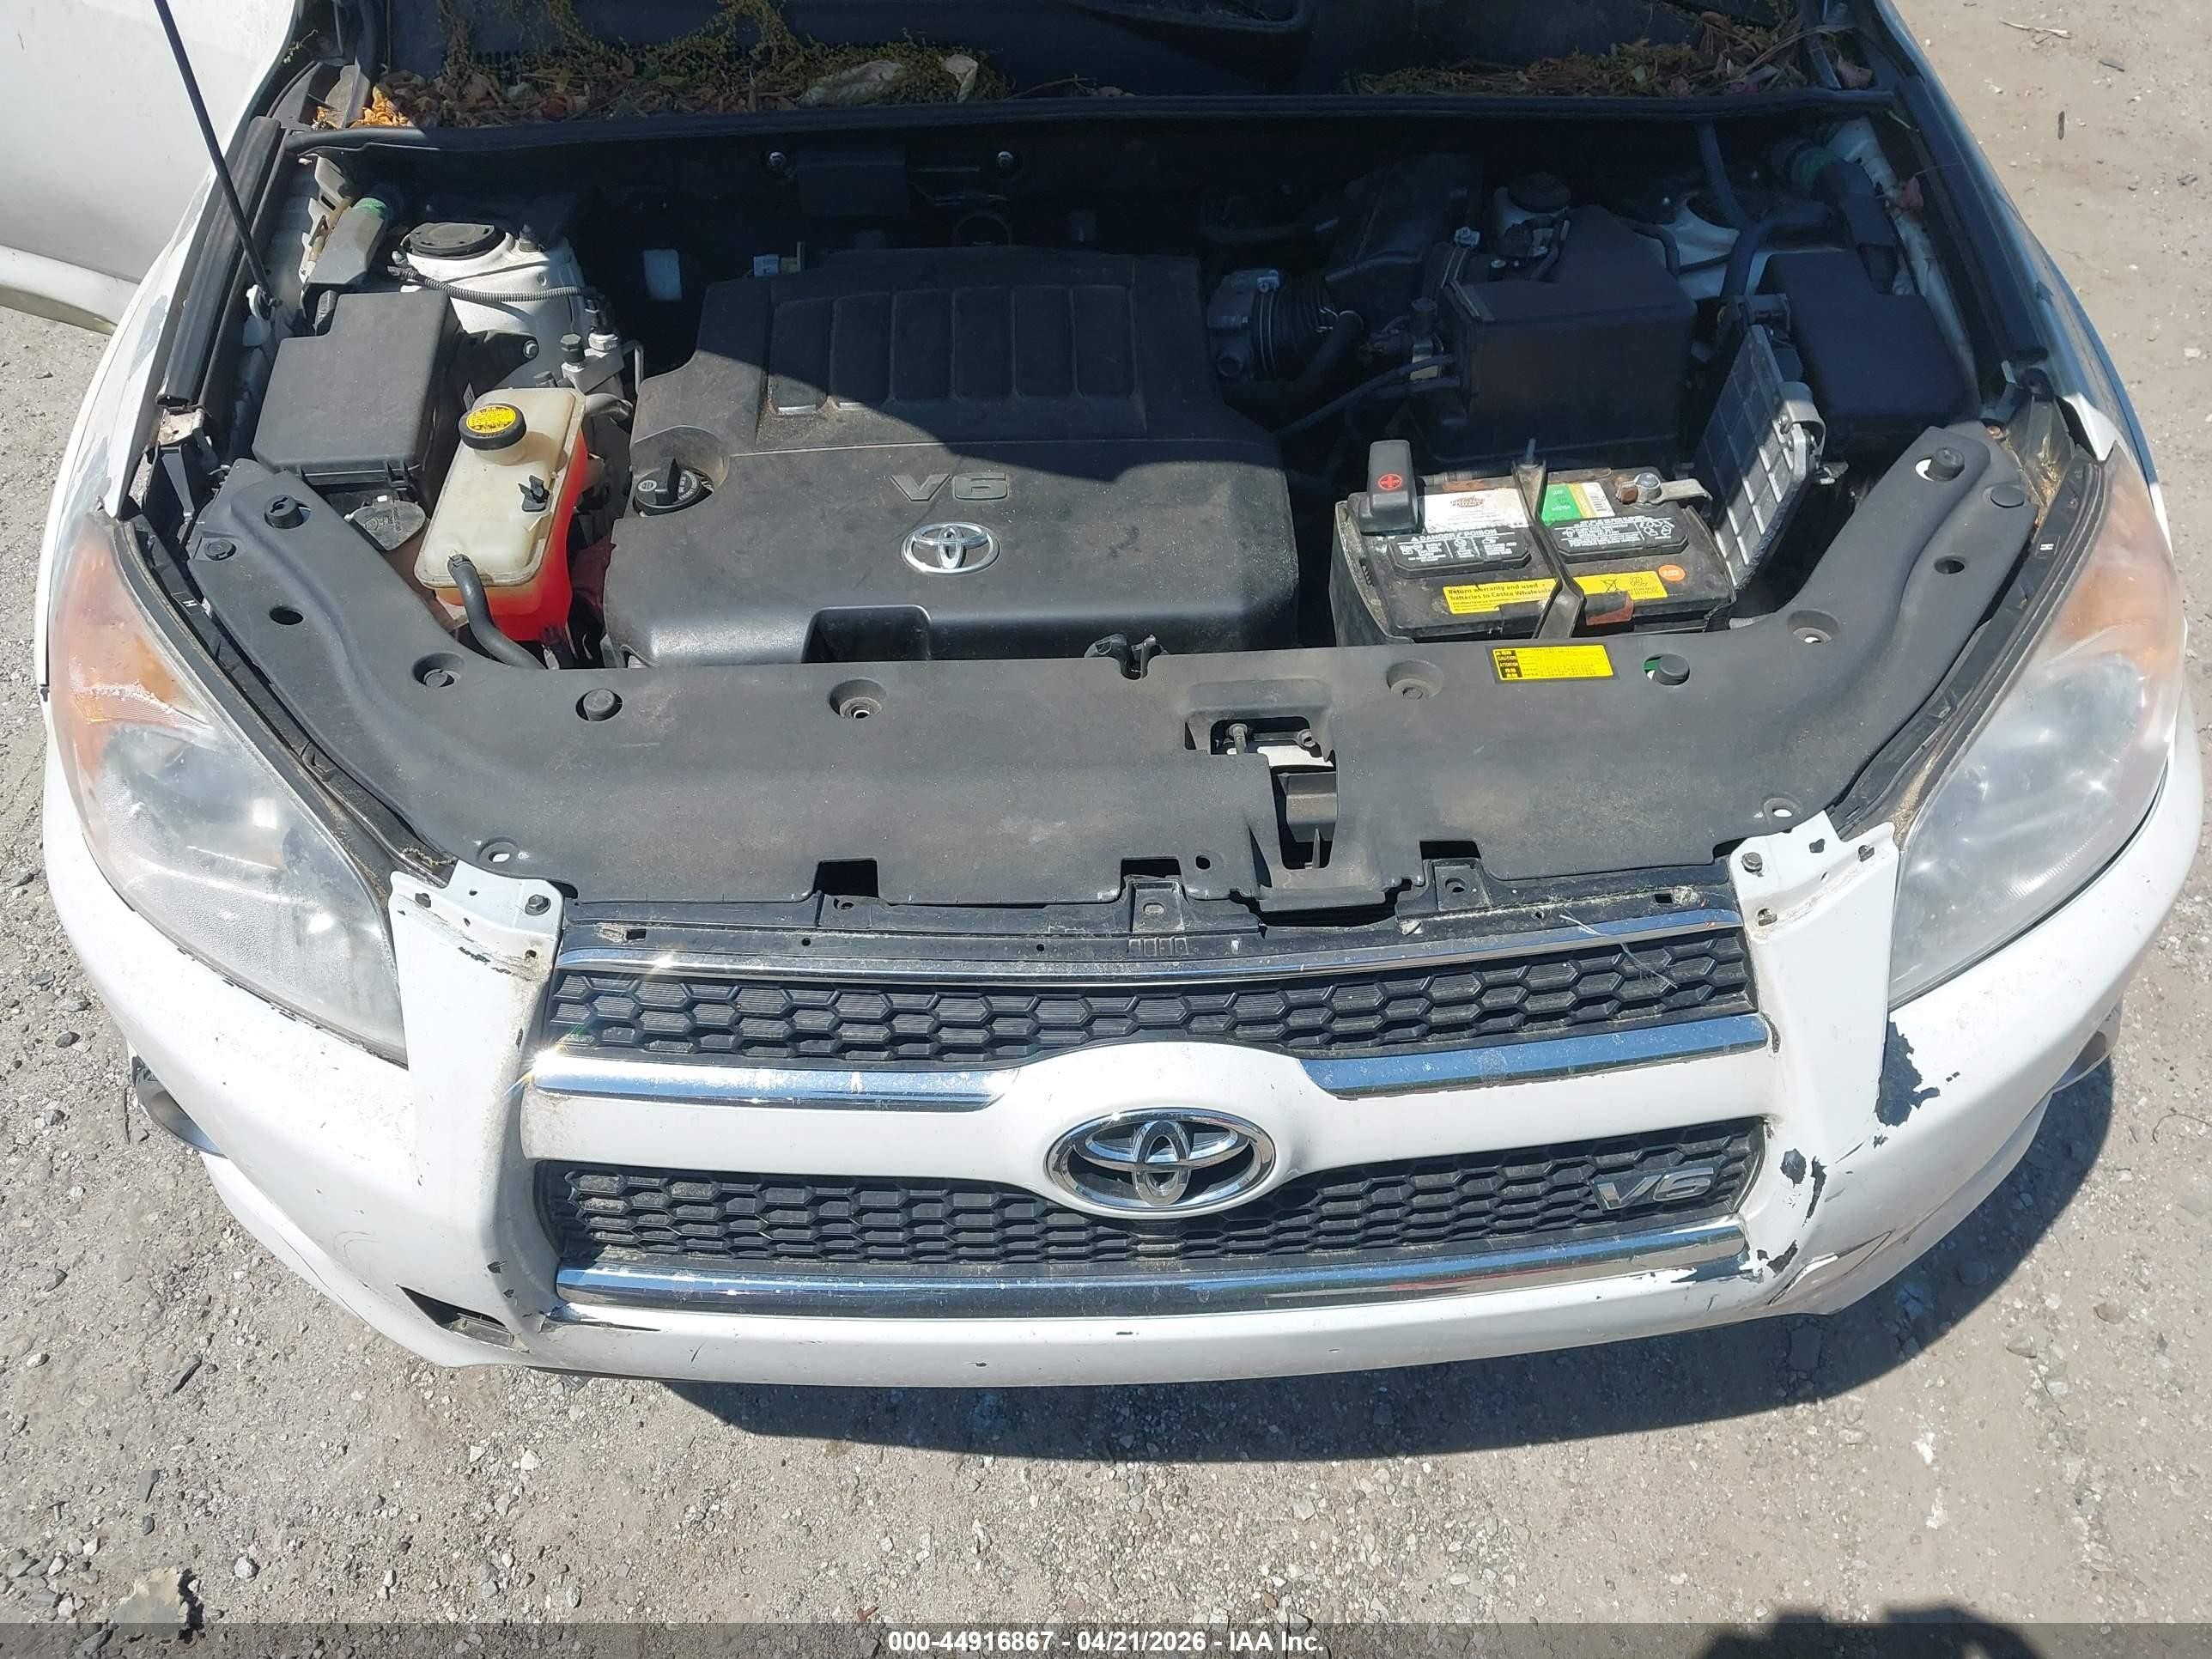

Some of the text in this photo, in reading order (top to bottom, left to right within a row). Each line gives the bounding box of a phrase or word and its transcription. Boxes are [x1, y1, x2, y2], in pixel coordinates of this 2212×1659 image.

[891, 472, 1009, 501] V6
[1418, 532, 1456, 542] DANGER
[1597, 1167, 1714, 1210] V6
